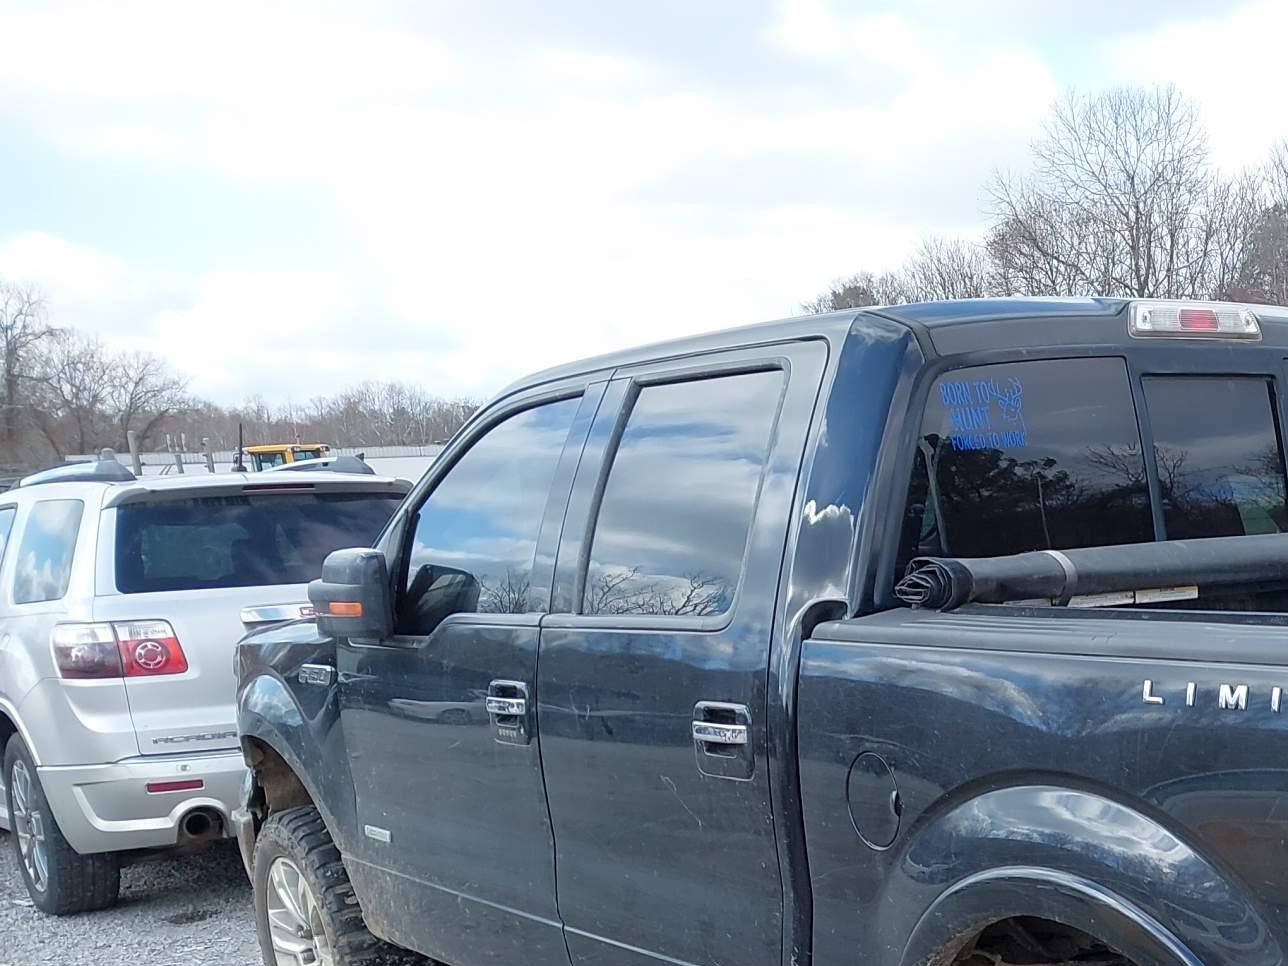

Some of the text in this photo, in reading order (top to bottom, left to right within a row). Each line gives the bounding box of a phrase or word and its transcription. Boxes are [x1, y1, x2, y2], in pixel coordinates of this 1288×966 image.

[940, 382, 991, 406] BORN TO
[950, 407, 991, 431] HUNT
[951, 431, 1028, 452] FORCED TO WORK
